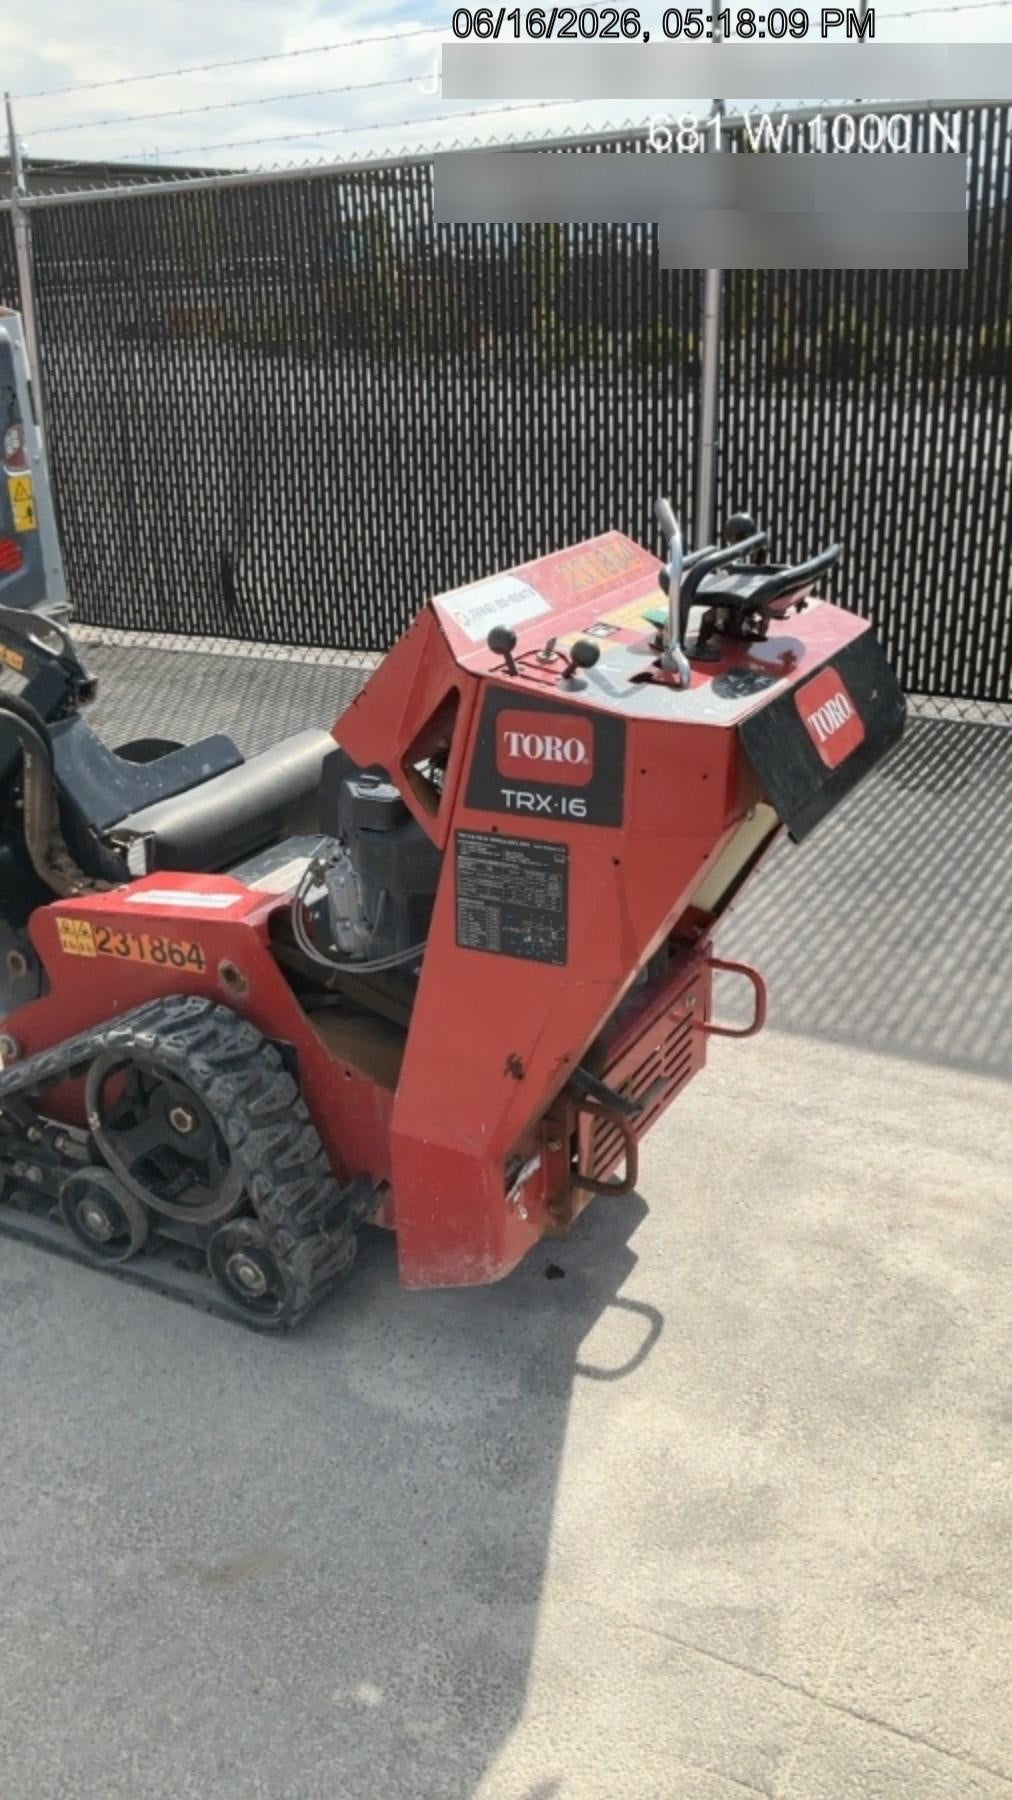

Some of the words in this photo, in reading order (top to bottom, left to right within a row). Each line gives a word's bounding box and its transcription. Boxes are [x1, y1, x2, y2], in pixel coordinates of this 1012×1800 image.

[807, 691, 851, 742] TORO
[503, 731, 586, 764] TORO
[95, 926, 205, 970] 231864
